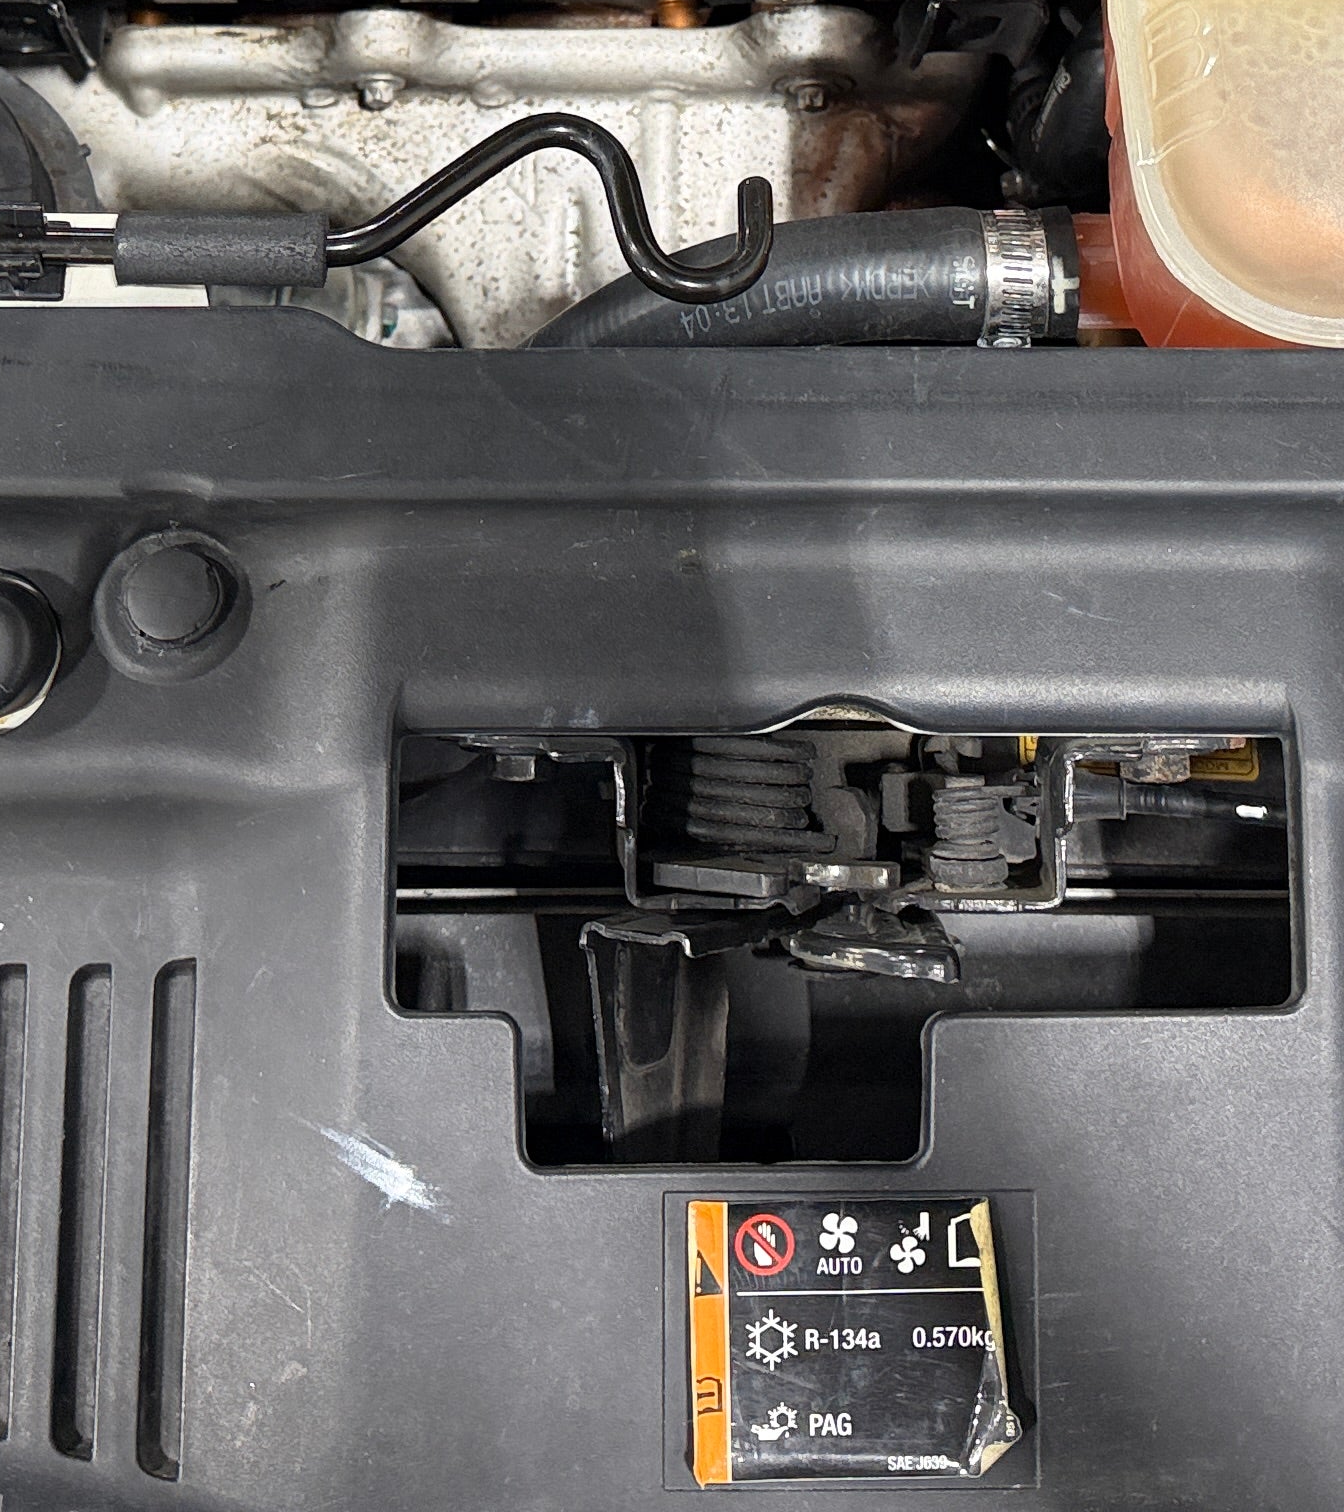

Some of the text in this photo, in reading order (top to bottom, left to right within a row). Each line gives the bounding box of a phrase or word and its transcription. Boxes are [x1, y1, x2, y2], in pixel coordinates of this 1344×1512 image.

[817, 1257, 863, 1276] AUTO
[805, 1326, 996, 1352] R-134a 0.570kg
[809, 1413, 853, 1437] PAG
[887, 1456, 914, 1471] SAE
